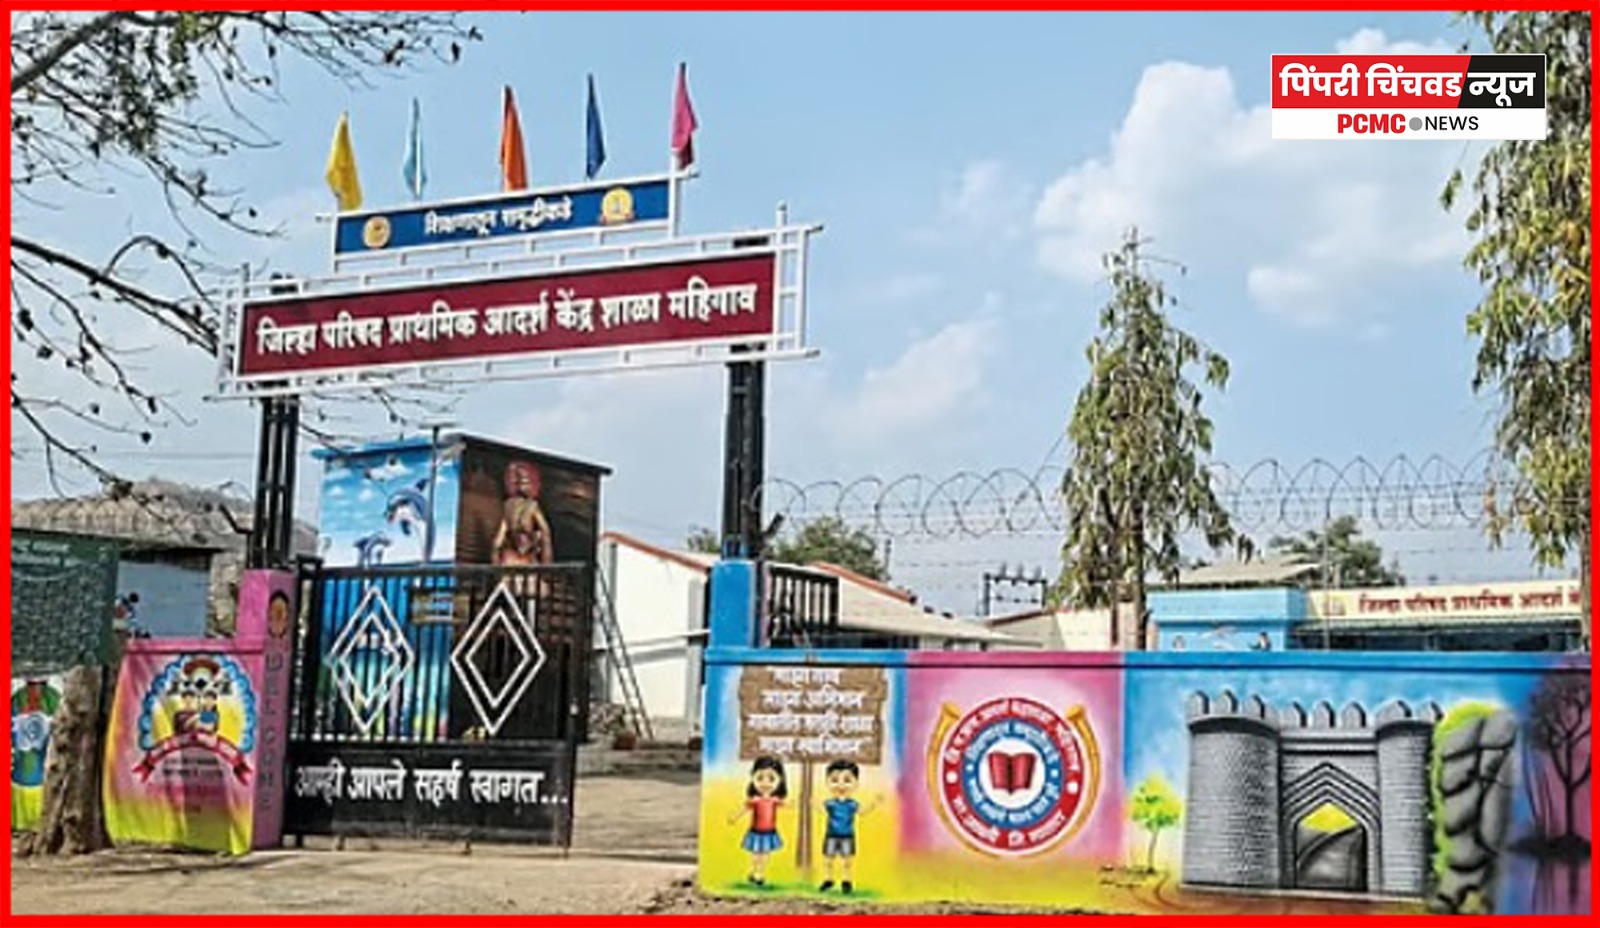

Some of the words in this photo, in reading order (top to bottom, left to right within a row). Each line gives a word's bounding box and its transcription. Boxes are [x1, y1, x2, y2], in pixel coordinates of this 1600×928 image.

[256, 317, 317, 356] जिल्हा
[321, 310, 382, 350] परिषद
[387, 300, 478, 345] प्राथमिक
[483, 290, 548, 334] आदर्श
[553, 288, 596, 332] केंद्र
[600, 292, 661, 331] शाळा
[295, 758, 346, 804] आम्ही
[347, 759, 406, 800] आपले
[413, 758, 463, 807] सहर्ष
